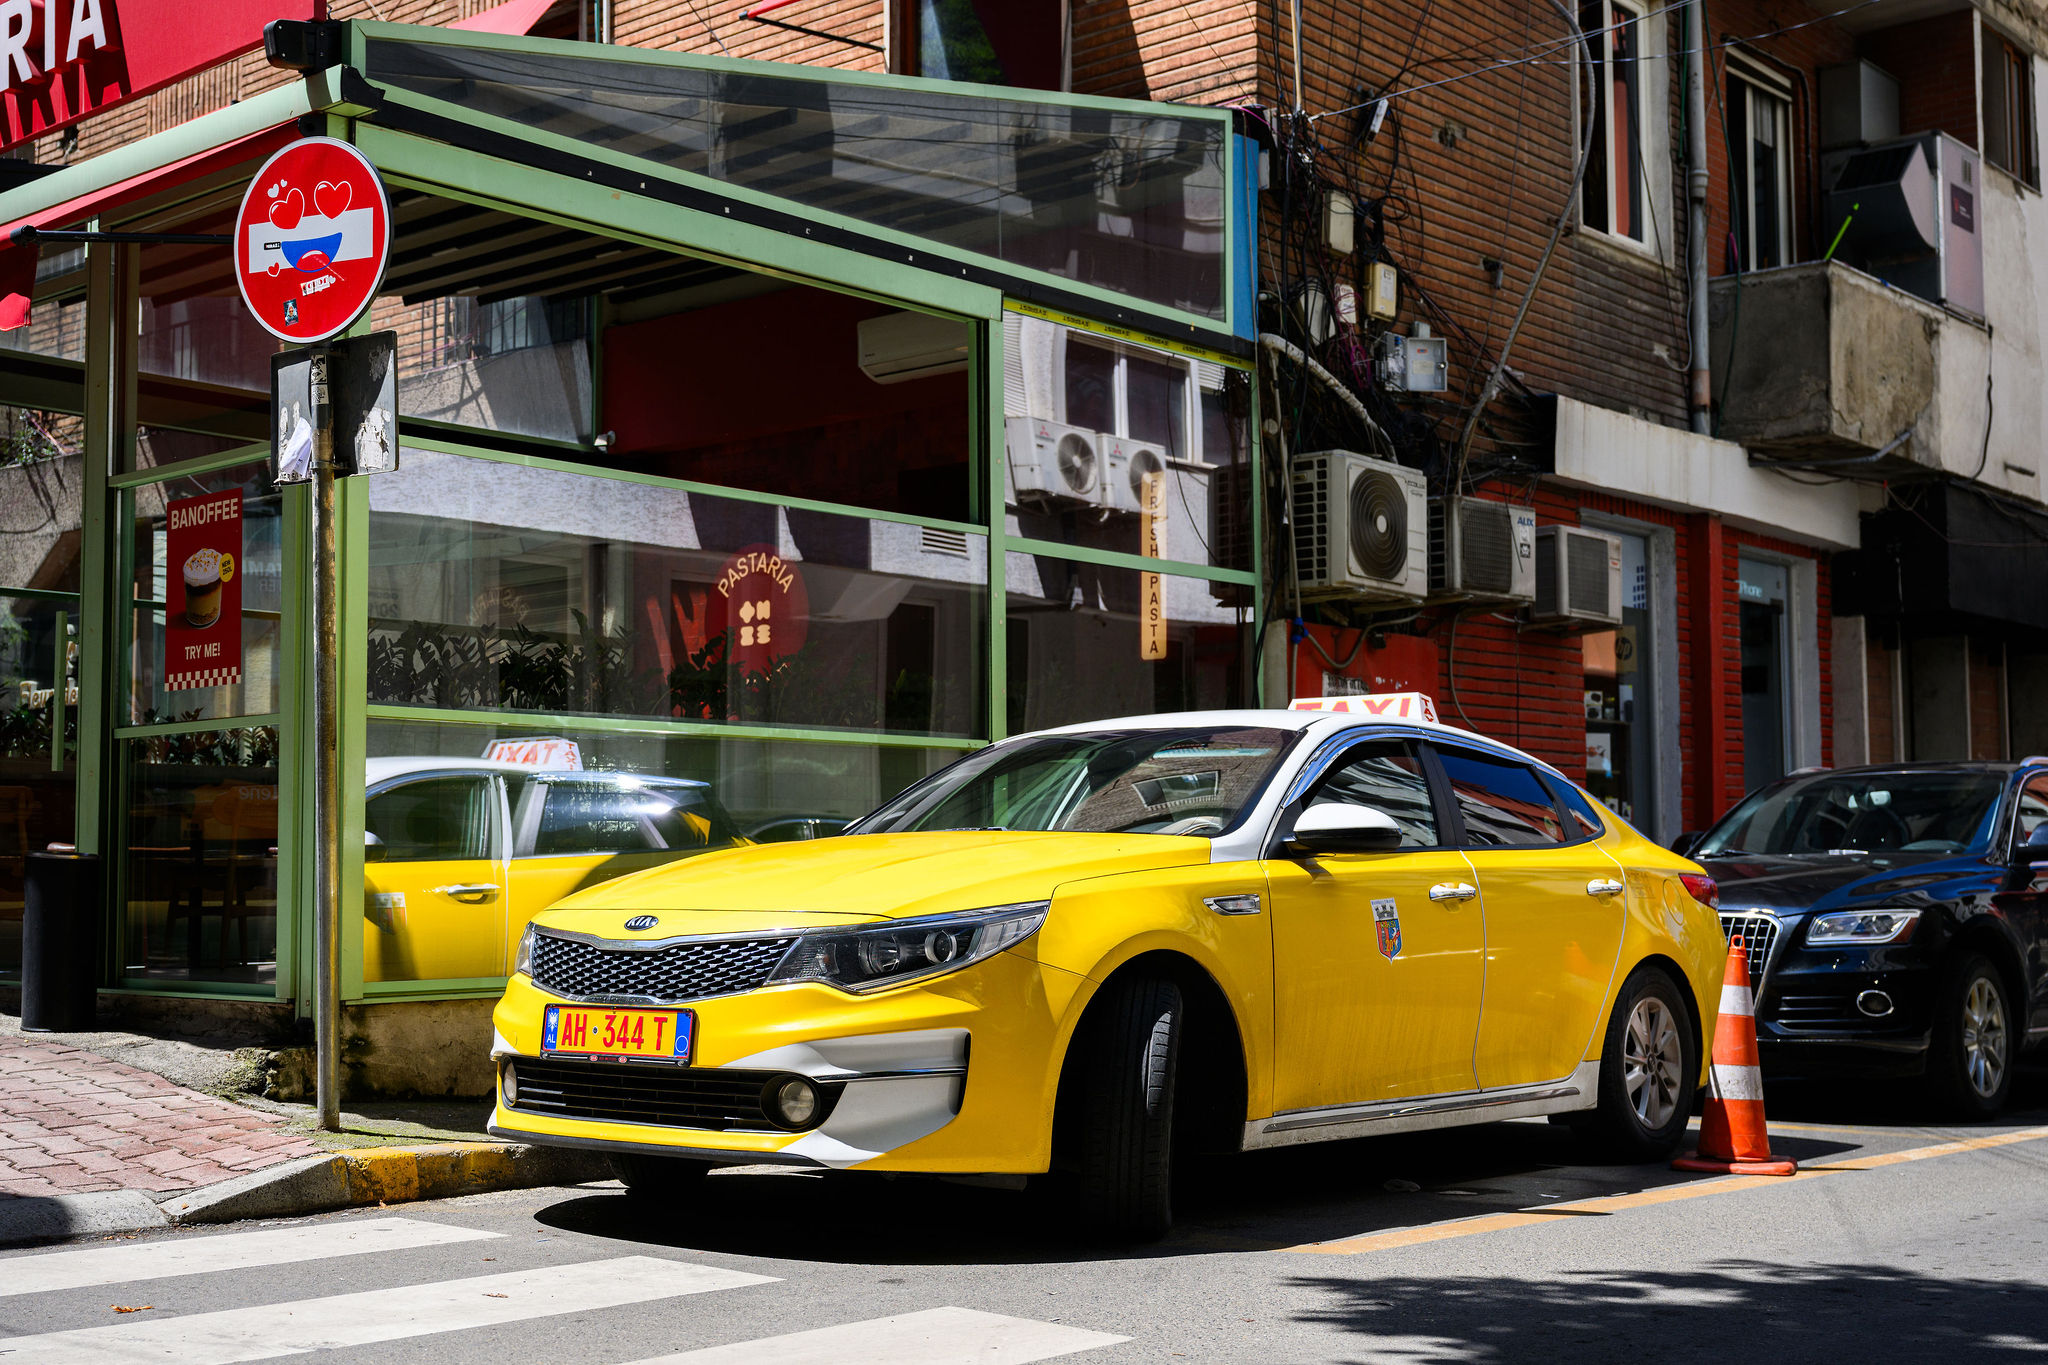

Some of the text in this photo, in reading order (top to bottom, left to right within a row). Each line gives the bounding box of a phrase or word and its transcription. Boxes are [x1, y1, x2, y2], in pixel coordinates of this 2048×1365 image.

[171, 498, 239, 530] BANOFFEE
[718, 552, 794, 598] PASTARIA
[1150, 480, 1159, 654] FRESH PASTA
[185, 642, 221, 660] TRY ME!
[1615, 637, 1632, 660] hp
[626, 916, 653, 927] KIA
[546, 1034, 556, 1044] AL
[561, 1013, 668, 1051] AH 344 T
